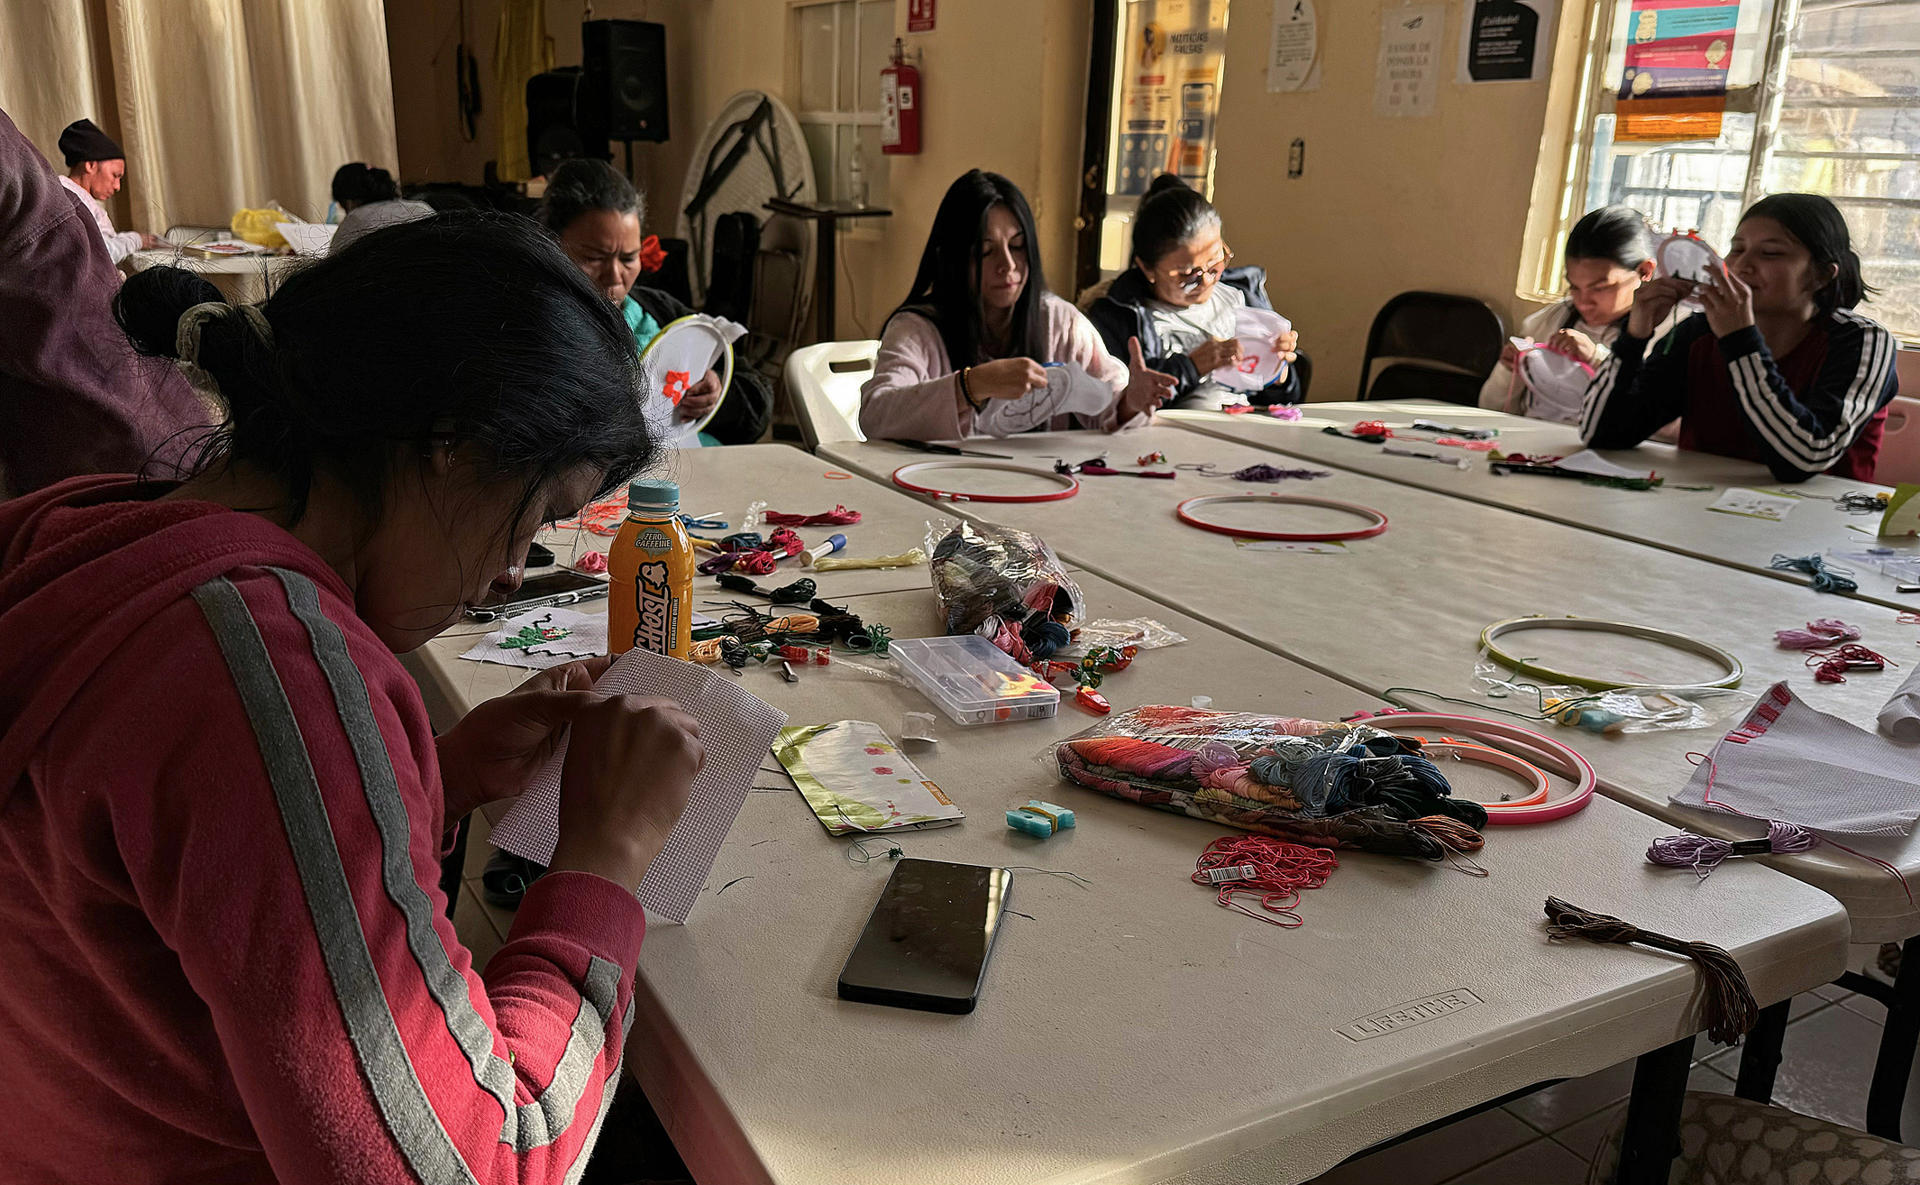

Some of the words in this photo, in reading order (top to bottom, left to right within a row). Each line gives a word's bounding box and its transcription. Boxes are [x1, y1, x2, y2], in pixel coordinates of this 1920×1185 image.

[644, 533, 663, 541] ZERO
[635, 539, 671, 548] CAFFEINE
[1351, 994, 1467, 1035] LIFETIME
